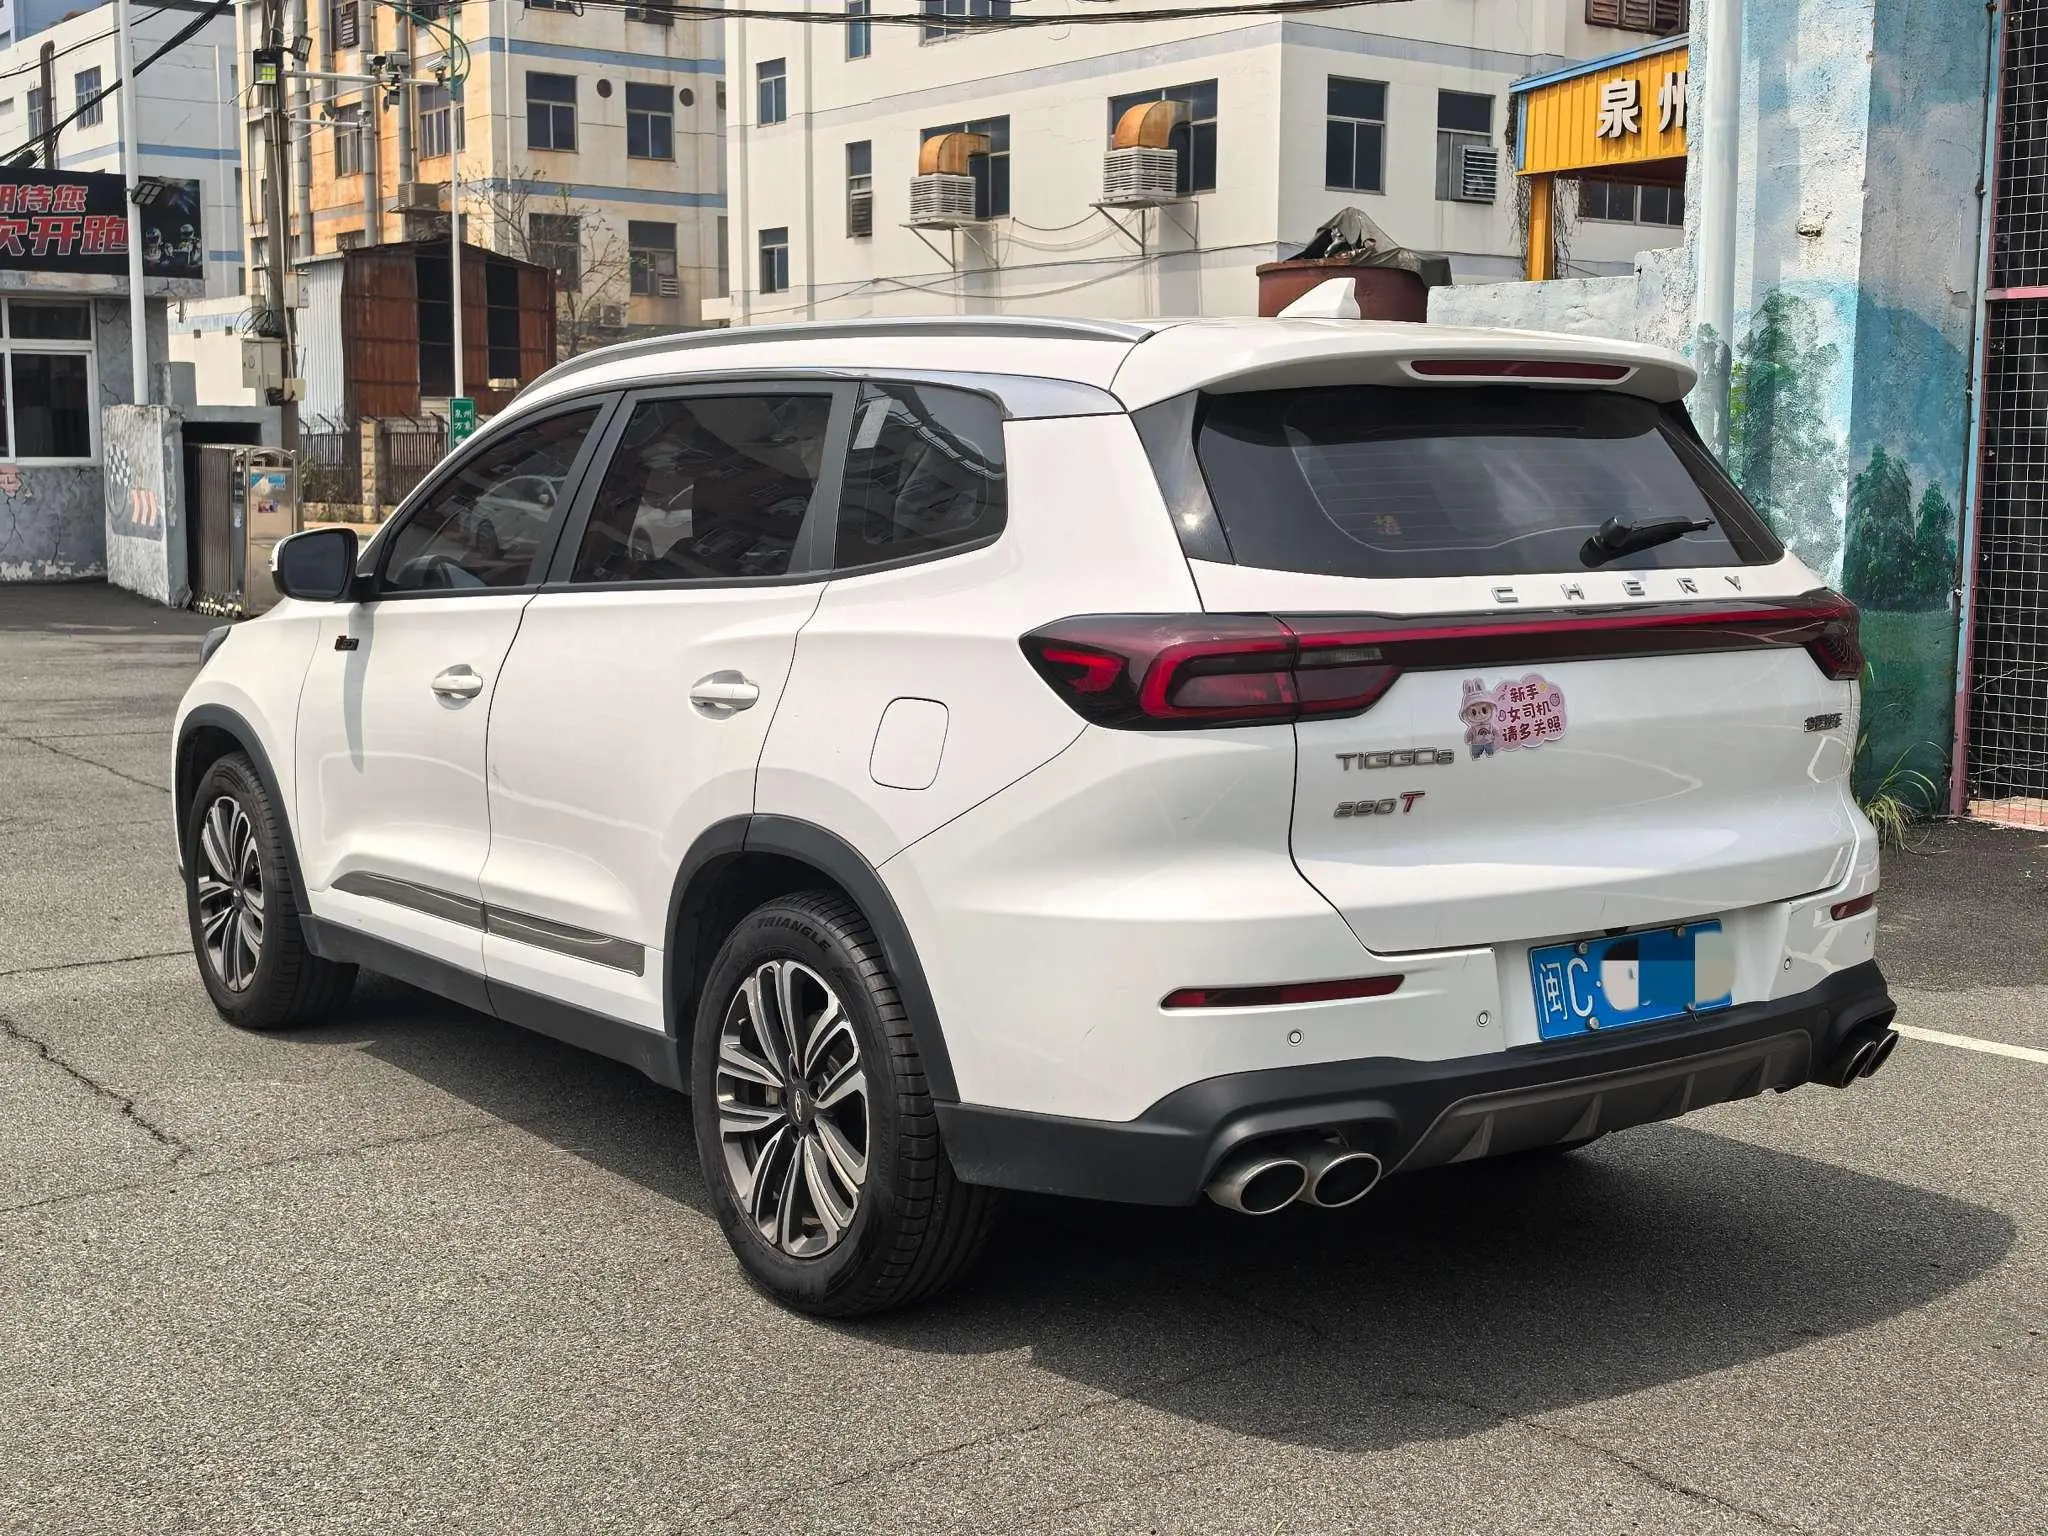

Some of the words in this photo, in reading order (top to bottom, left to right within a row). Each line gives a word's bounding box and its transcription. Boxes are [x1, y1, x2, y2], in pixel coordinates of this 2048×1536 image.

[1596, 70, 1689, 138] 泉州
[1490, 575, 1743, 603] CHERY
[1510, 683, 1540, 703] 新手
[1507, 701, 1552, 723] 女司机
[1503, 716, 1562, 742] 请多关照
[757, 916, 832, 952] TRIANGLE
